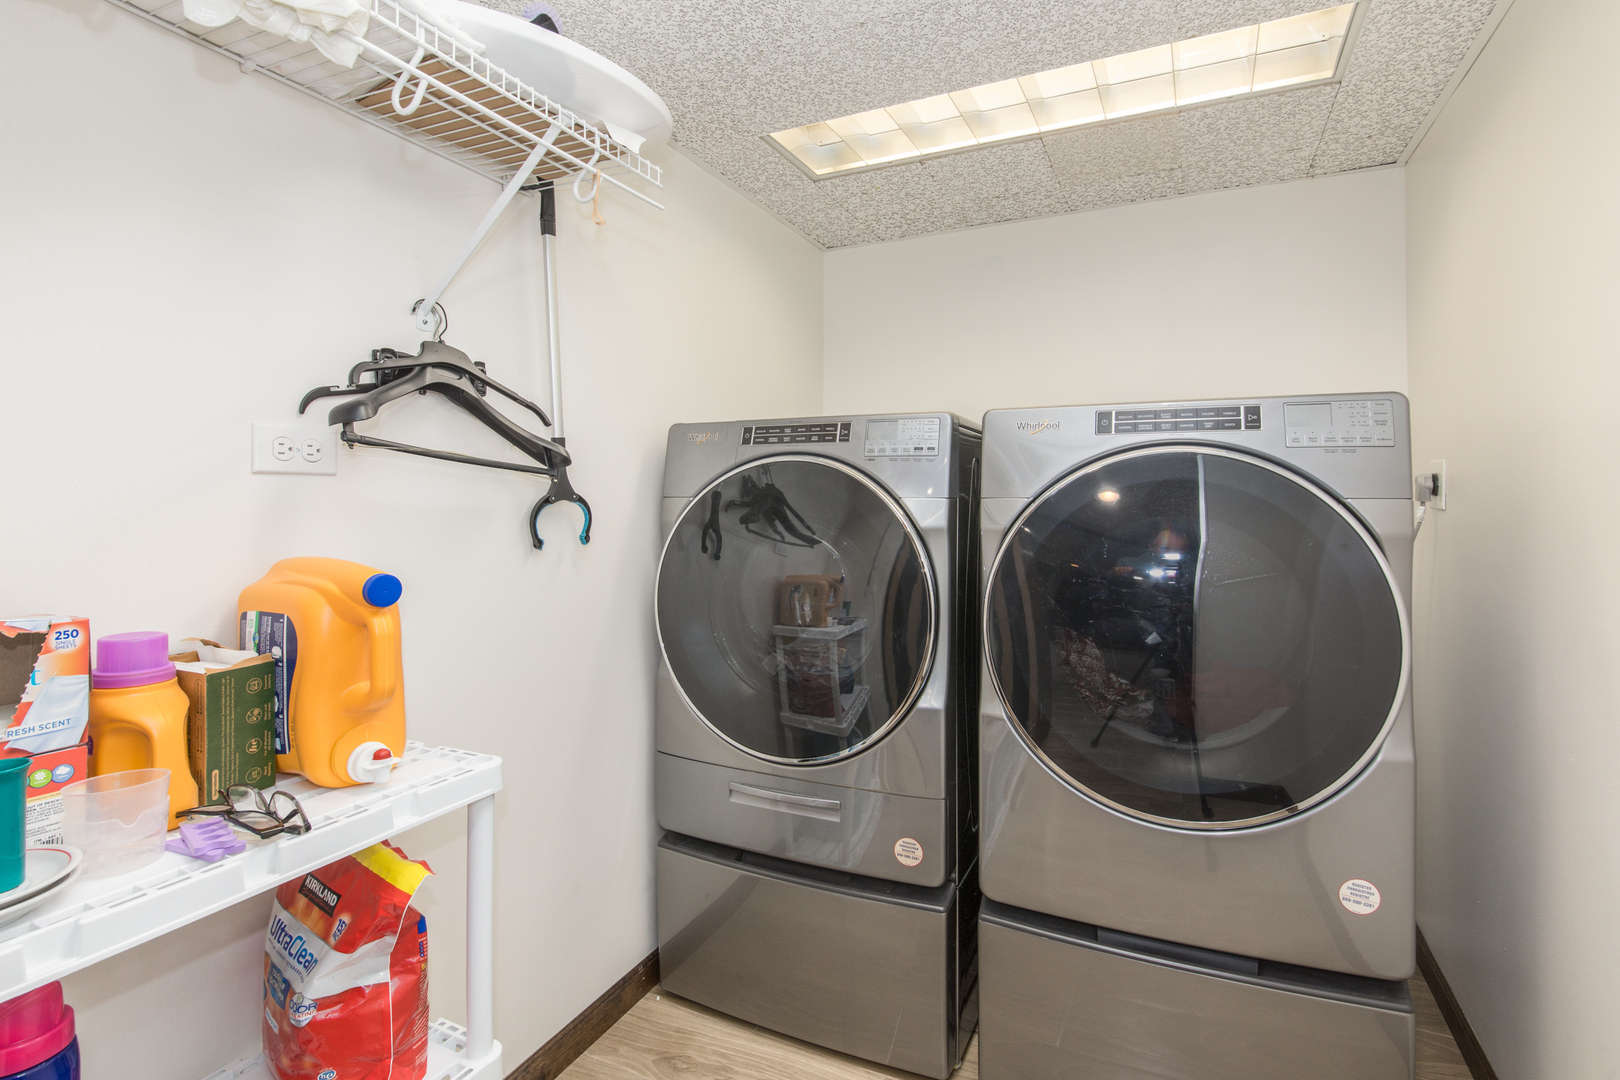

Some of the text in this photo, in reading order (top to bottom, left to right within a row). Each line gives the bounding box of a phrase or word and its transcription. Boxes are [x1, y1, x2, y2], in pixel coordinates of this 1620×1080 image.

[1016, 420, 1060, 434] Whirlpool
[688, 432, 719, 444] Whirlpool
[54, 628, 79, 641] 250
[6, 718, 72, 738] RESH SCENT
[304, 874, 338, 907] KIRKLAND
[269, 914, 319, 976] UltraClean
